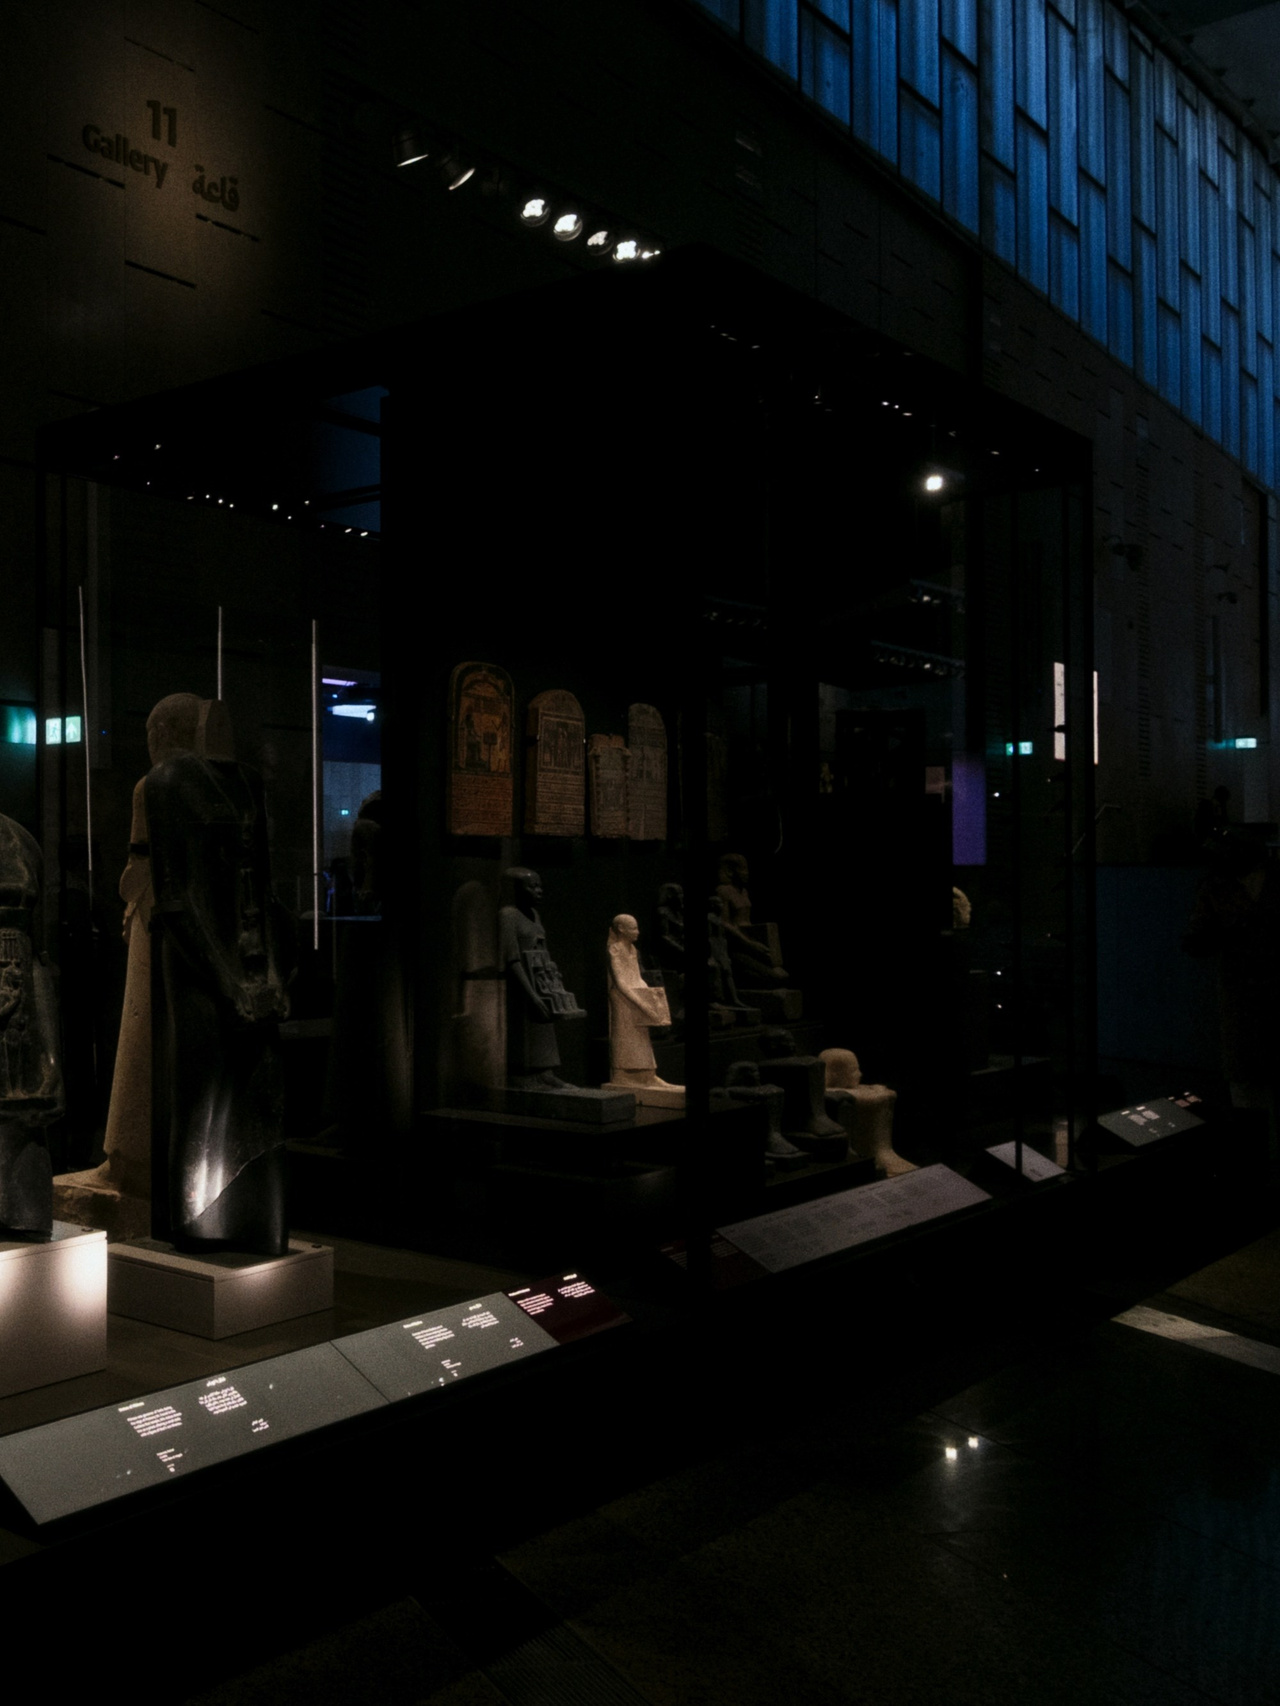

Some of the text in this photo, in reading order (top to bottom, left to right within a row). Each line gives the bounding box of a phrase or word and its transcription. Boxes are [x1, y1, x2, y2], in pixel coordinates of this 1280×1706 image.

[147, 100, 177, 147] 11
[82, 124, 169, 189] Gallery
[192, 164, 240, 212] قاعة
